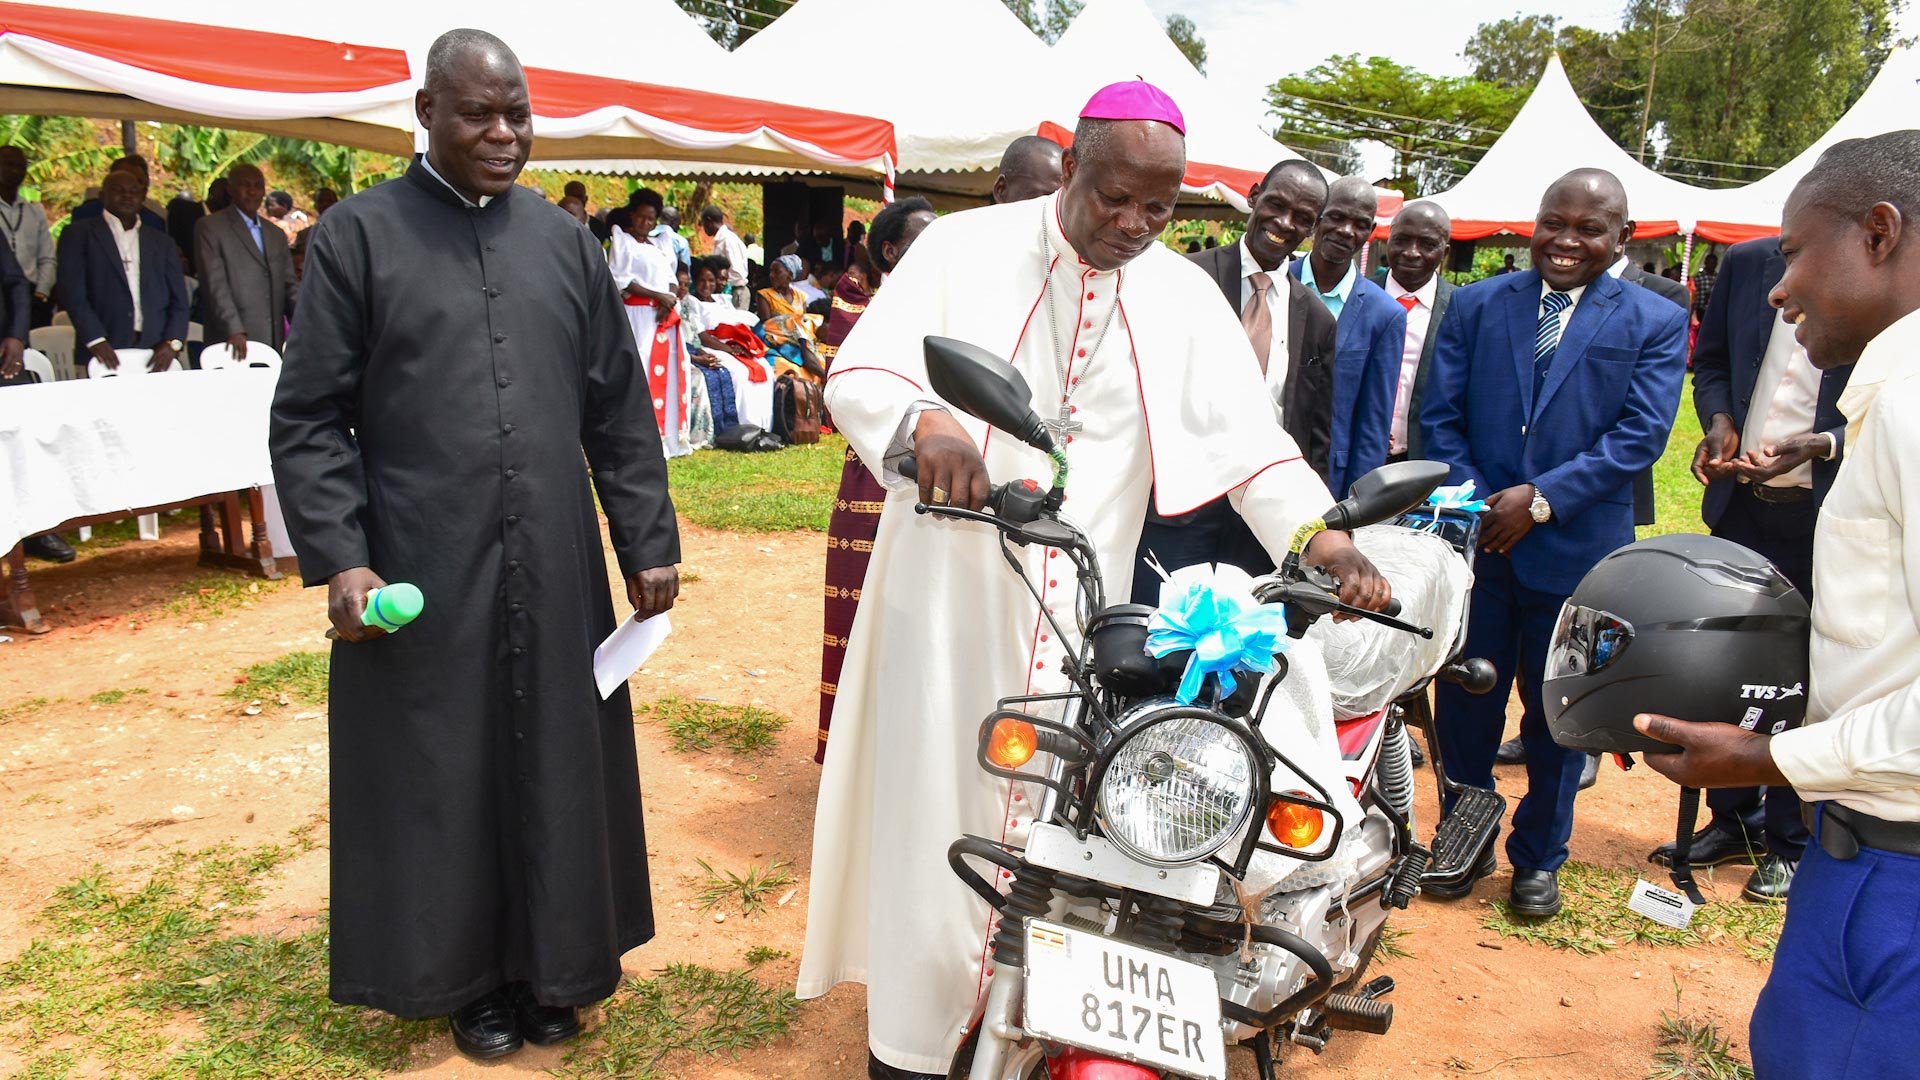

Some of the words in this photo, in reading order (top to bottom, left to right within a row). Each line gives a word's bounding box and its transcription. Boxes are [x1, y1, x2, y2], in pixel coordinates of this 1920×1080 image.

[1740, 684, 1777, 699] TVS
[1103, 951, 1175, 1006] UMA
[1082, 993, 1204, 1063] 817ER
